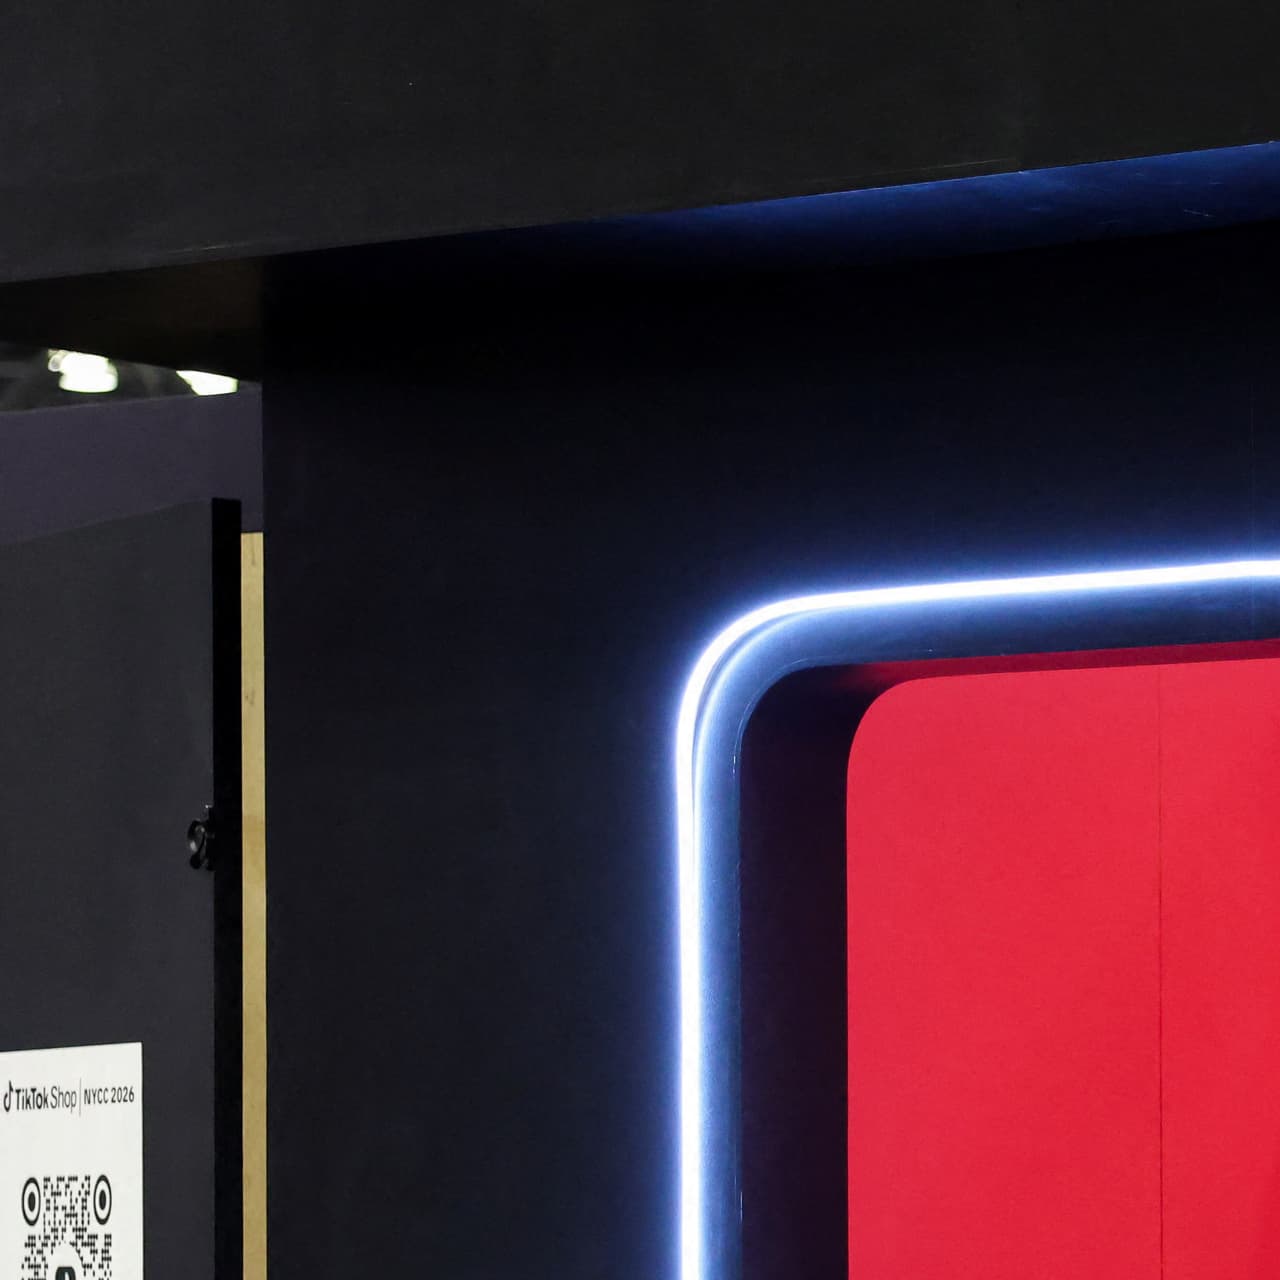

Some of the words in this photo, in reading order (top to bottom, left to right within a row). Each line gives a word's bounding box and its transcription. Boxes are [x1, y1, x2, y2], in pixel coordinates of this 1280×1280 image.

[15, 1086, 49, 1110] TikTok
[50, 1085, 77, 1114] Shop
[84, 1087, 109, 1105] NYCC
[111, 1086, 135, 1103] 2026
